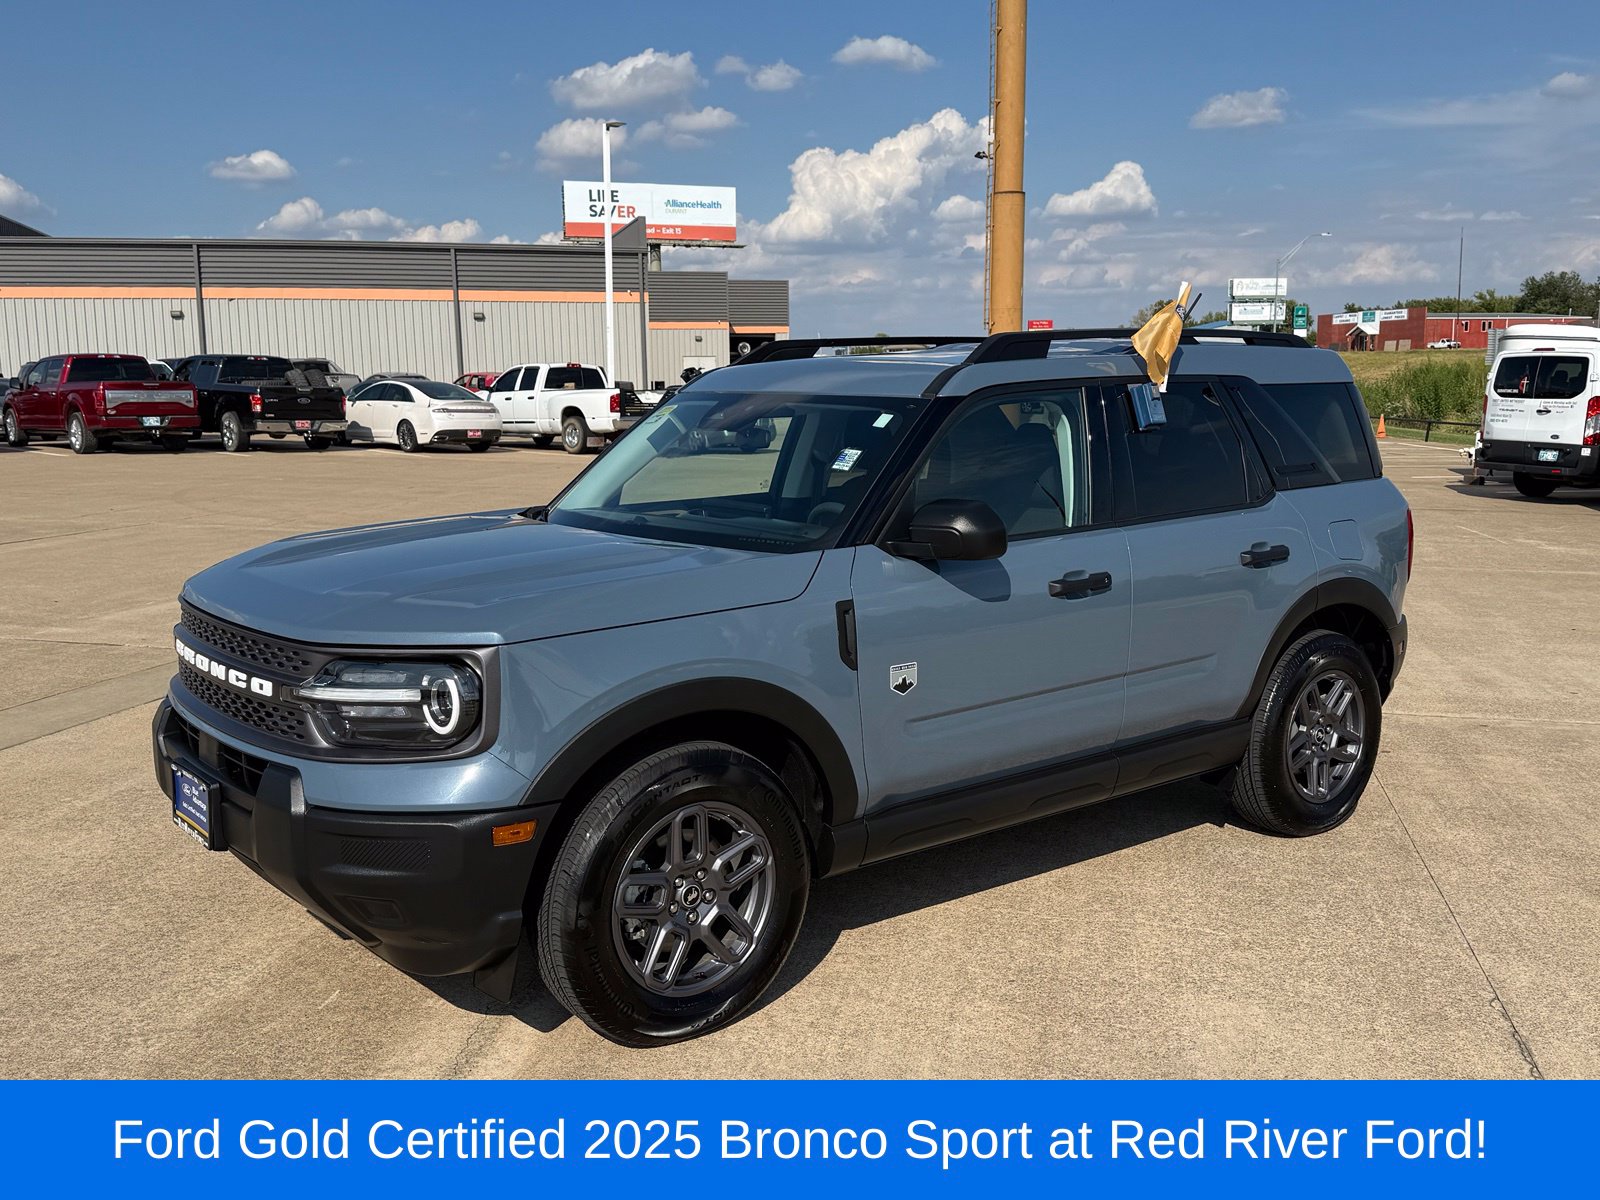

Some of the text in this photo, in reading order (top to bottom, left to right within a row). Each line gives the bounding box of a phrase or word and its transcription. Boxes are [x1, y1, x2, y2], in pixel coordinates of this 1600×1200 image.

[664, 199, 722, 209] AllianceHealth
[662, 227, 674, 235] Exit
[675, 227, 682, 235] 15
[175, 638, 273, 697] BRONCO
